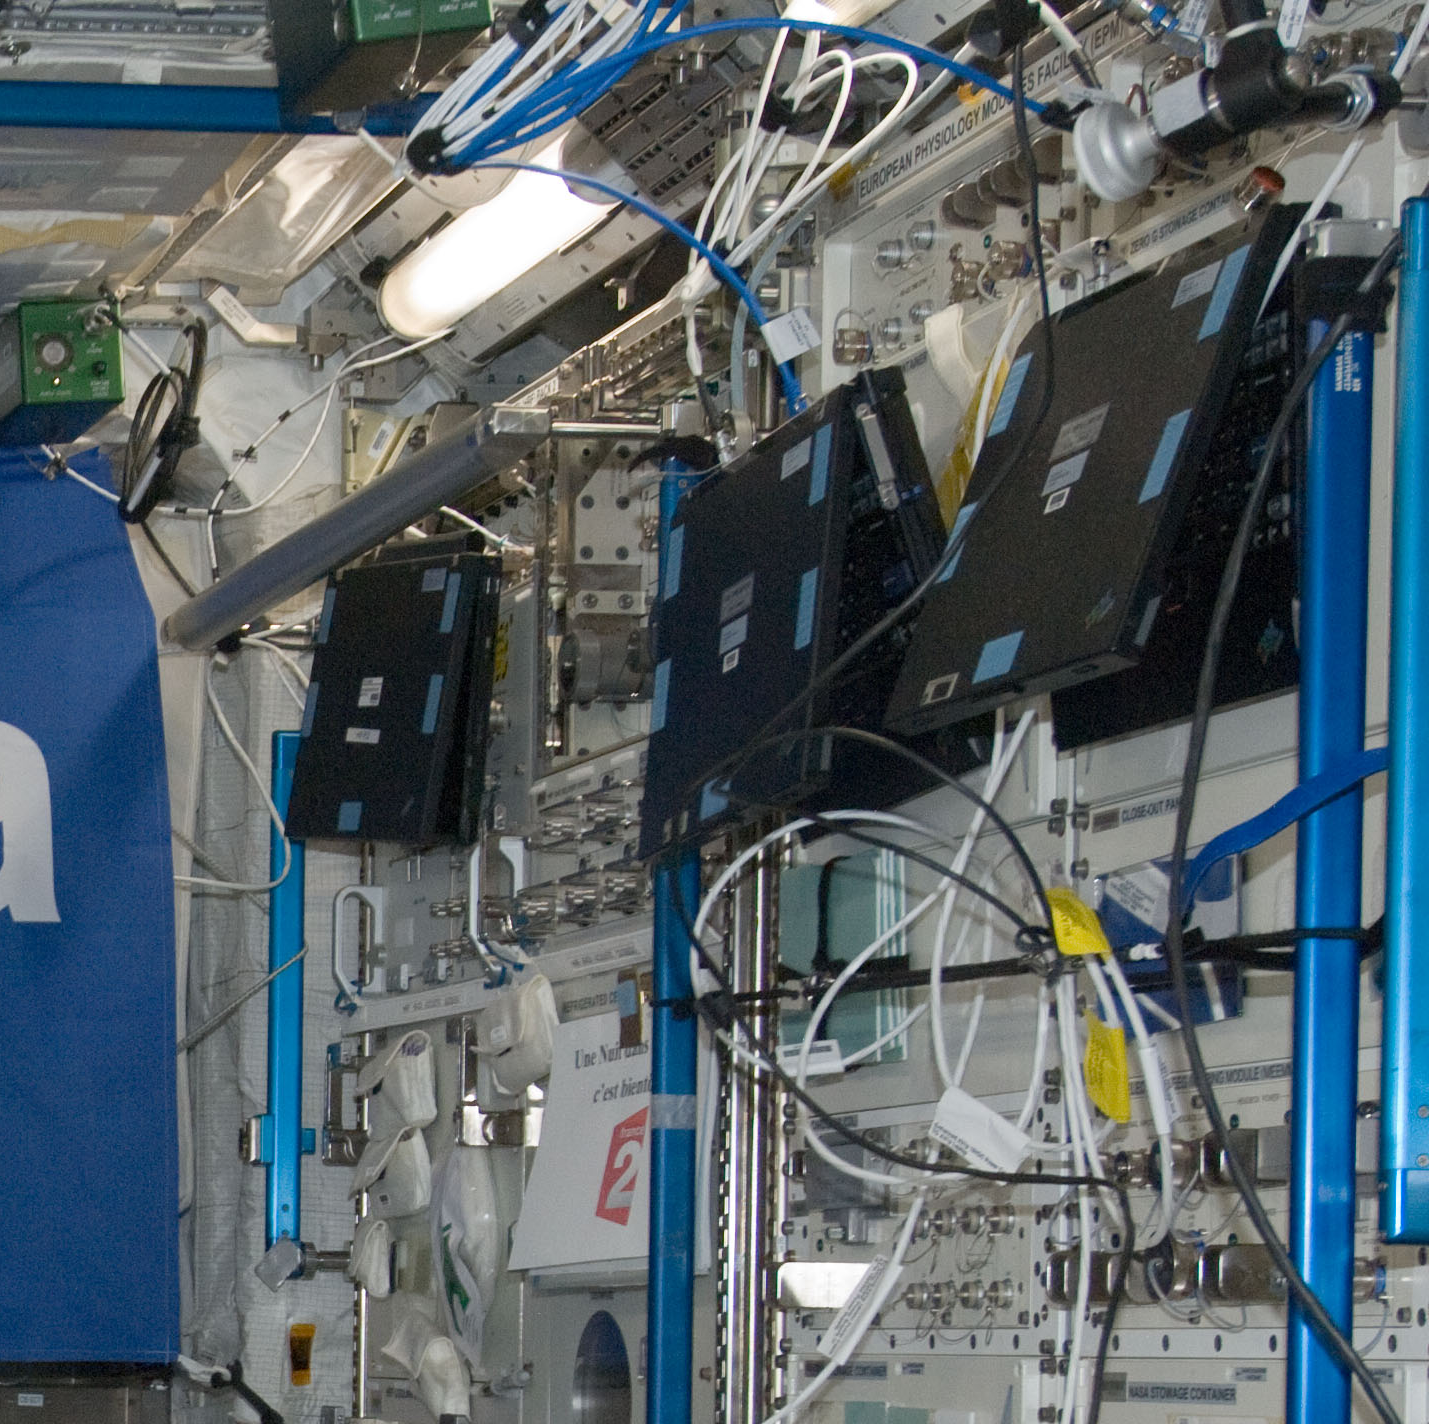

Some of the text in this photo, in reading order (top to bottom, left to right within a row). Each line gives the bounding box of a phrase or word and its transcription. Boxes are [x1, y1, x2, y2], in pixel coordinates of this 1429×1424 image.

[859, 17, 1125, 199] EUROPEAN PHYSIOLOGY MODES FACILY (EPM)
[1159, 207, 1198, 240] STOWAGE
[1121, 801, 1163, 822] CLOSE-OUT
[574, 1049, 597, 1070] Une
[604, 1140, 643, 1209] 2
[1129, 1386, 1236, 1400] NASA STOWAGE CONTAINER
